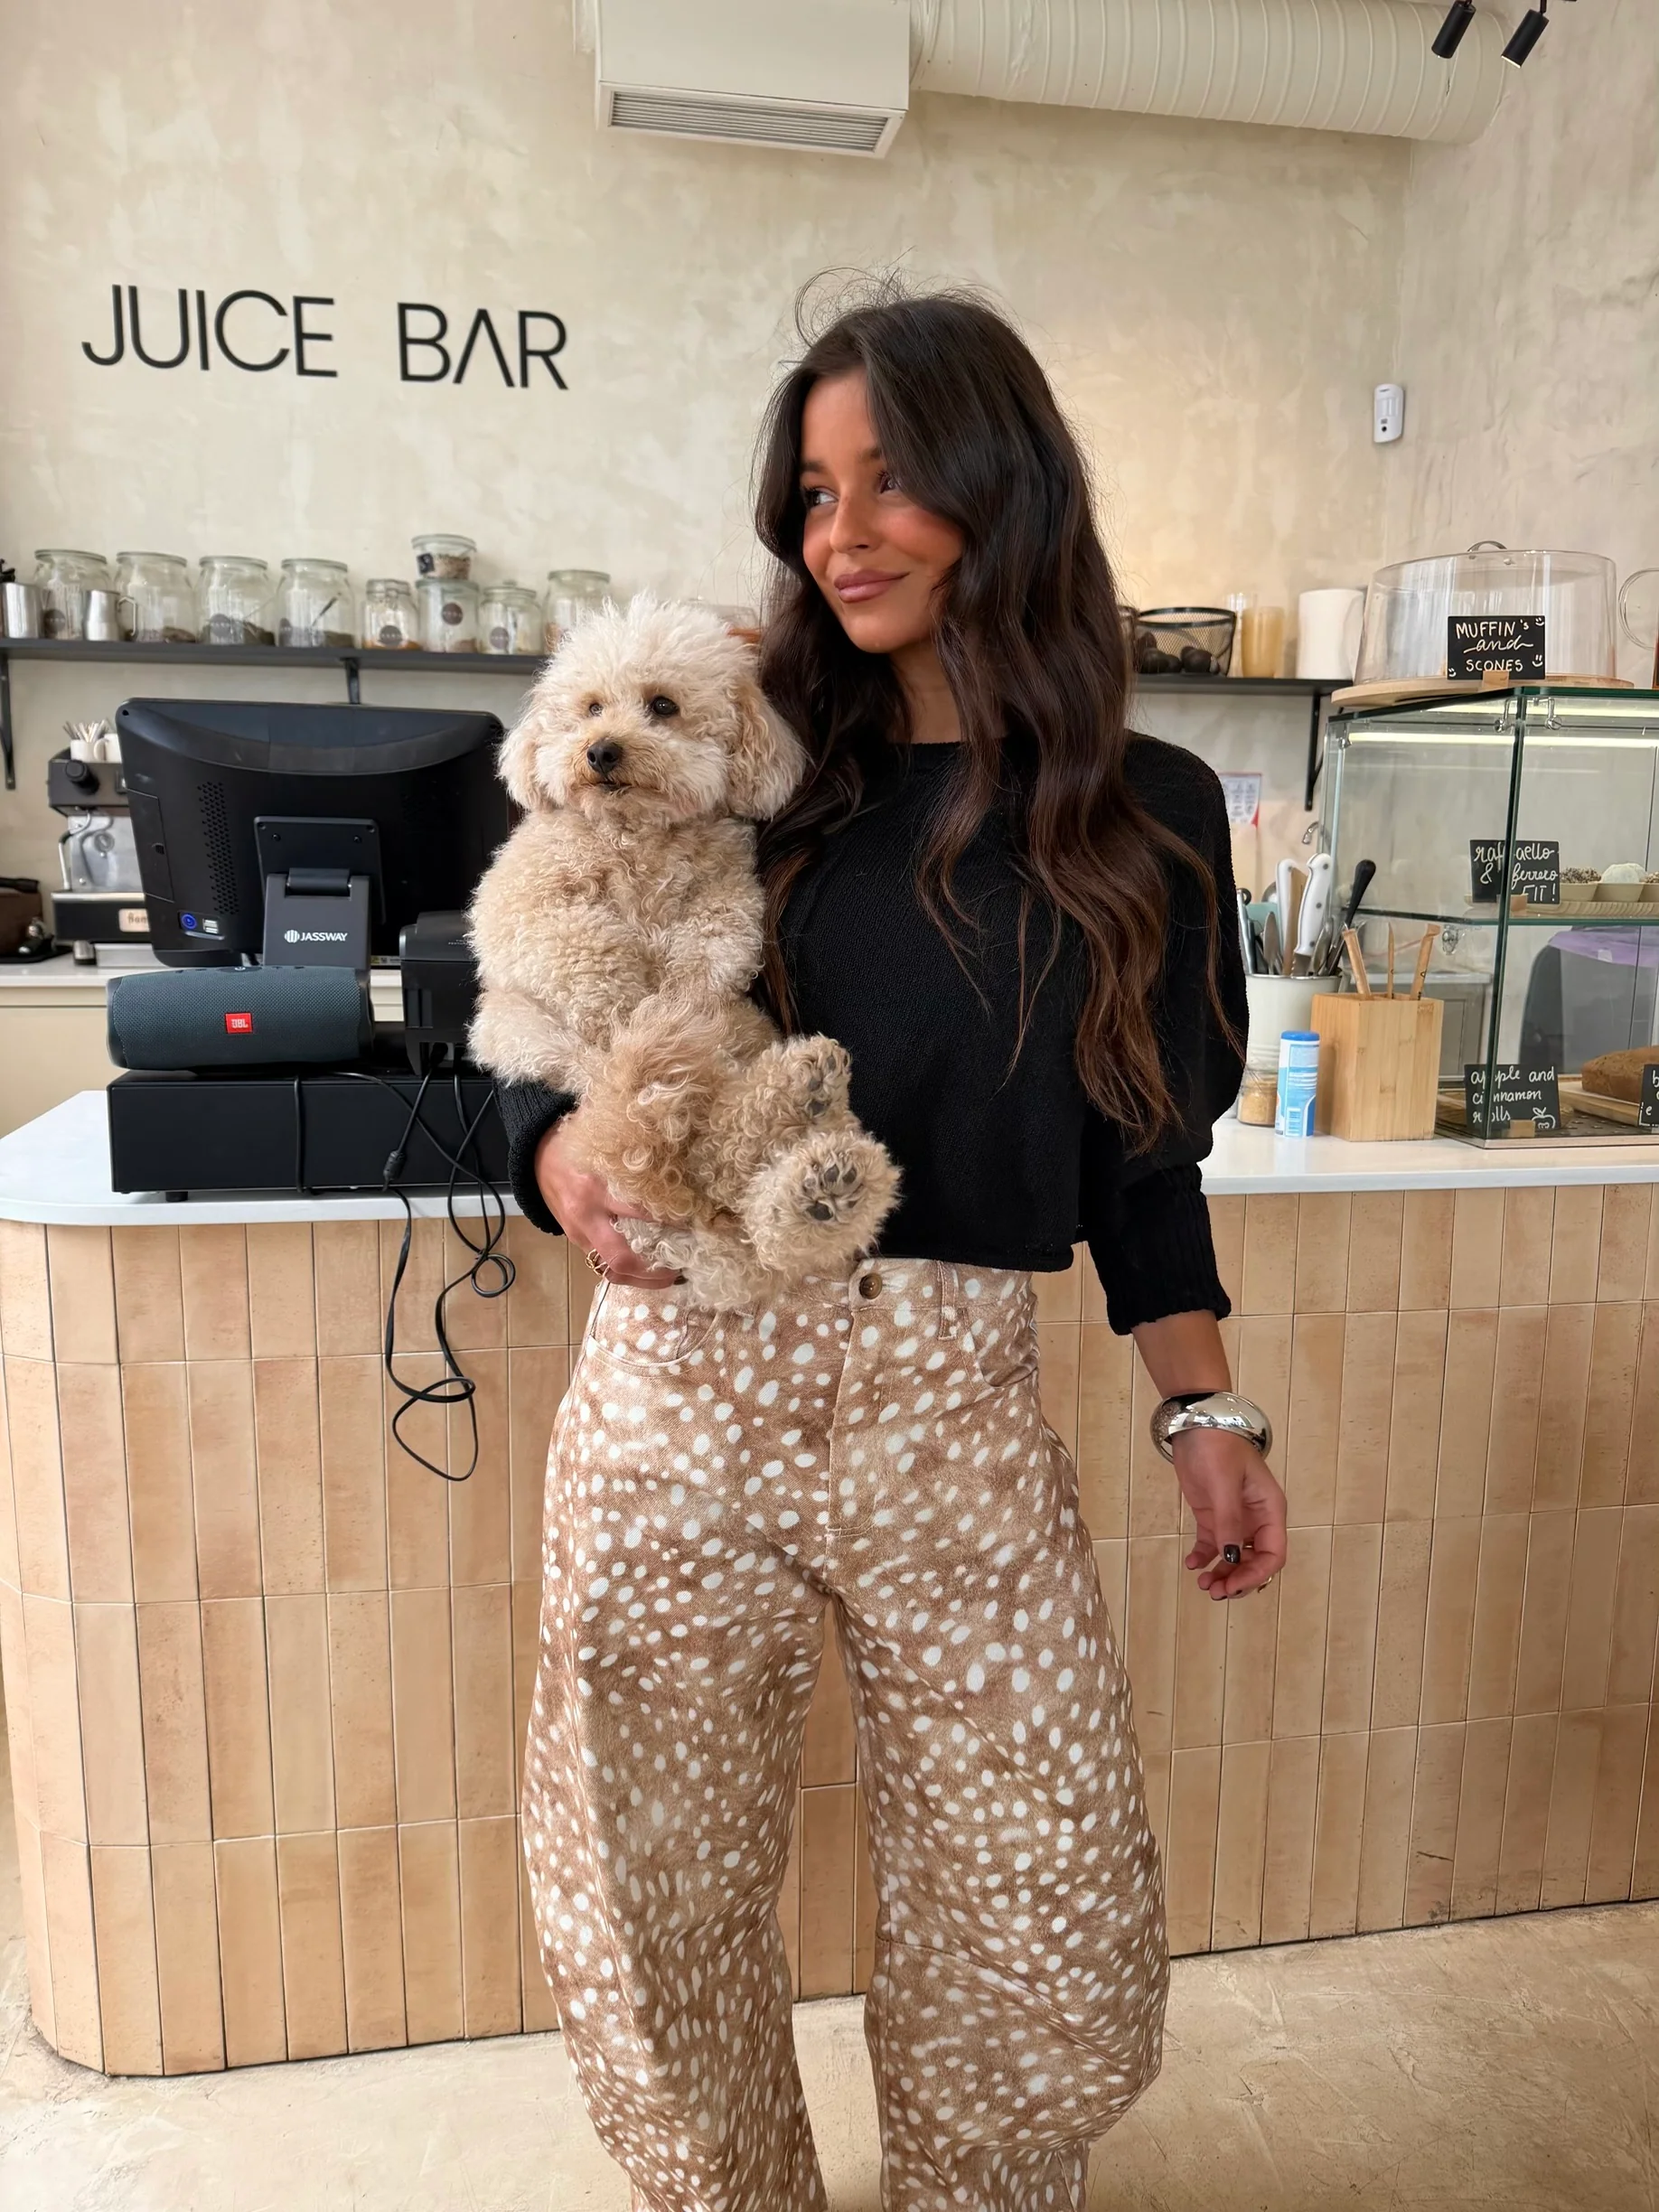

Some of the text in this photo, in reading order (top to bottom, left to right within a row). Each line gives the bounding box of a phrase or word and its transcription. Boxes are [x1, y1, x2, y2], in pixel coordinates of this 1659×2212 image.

[81, 284, 569, 389] JUICE BAR
[1463, 634, 1534, 653] and
[1466, 659, 1523, 672] SCONES
[1473, 841, 1555, 873] rafaello
[1479, 862, 1559, 891] & ferrero
[299, 932, 349, 942] JASSWAY
[230, 1018, 248, 1029] JBL
[1528, 1065, 1555, 1083] and
